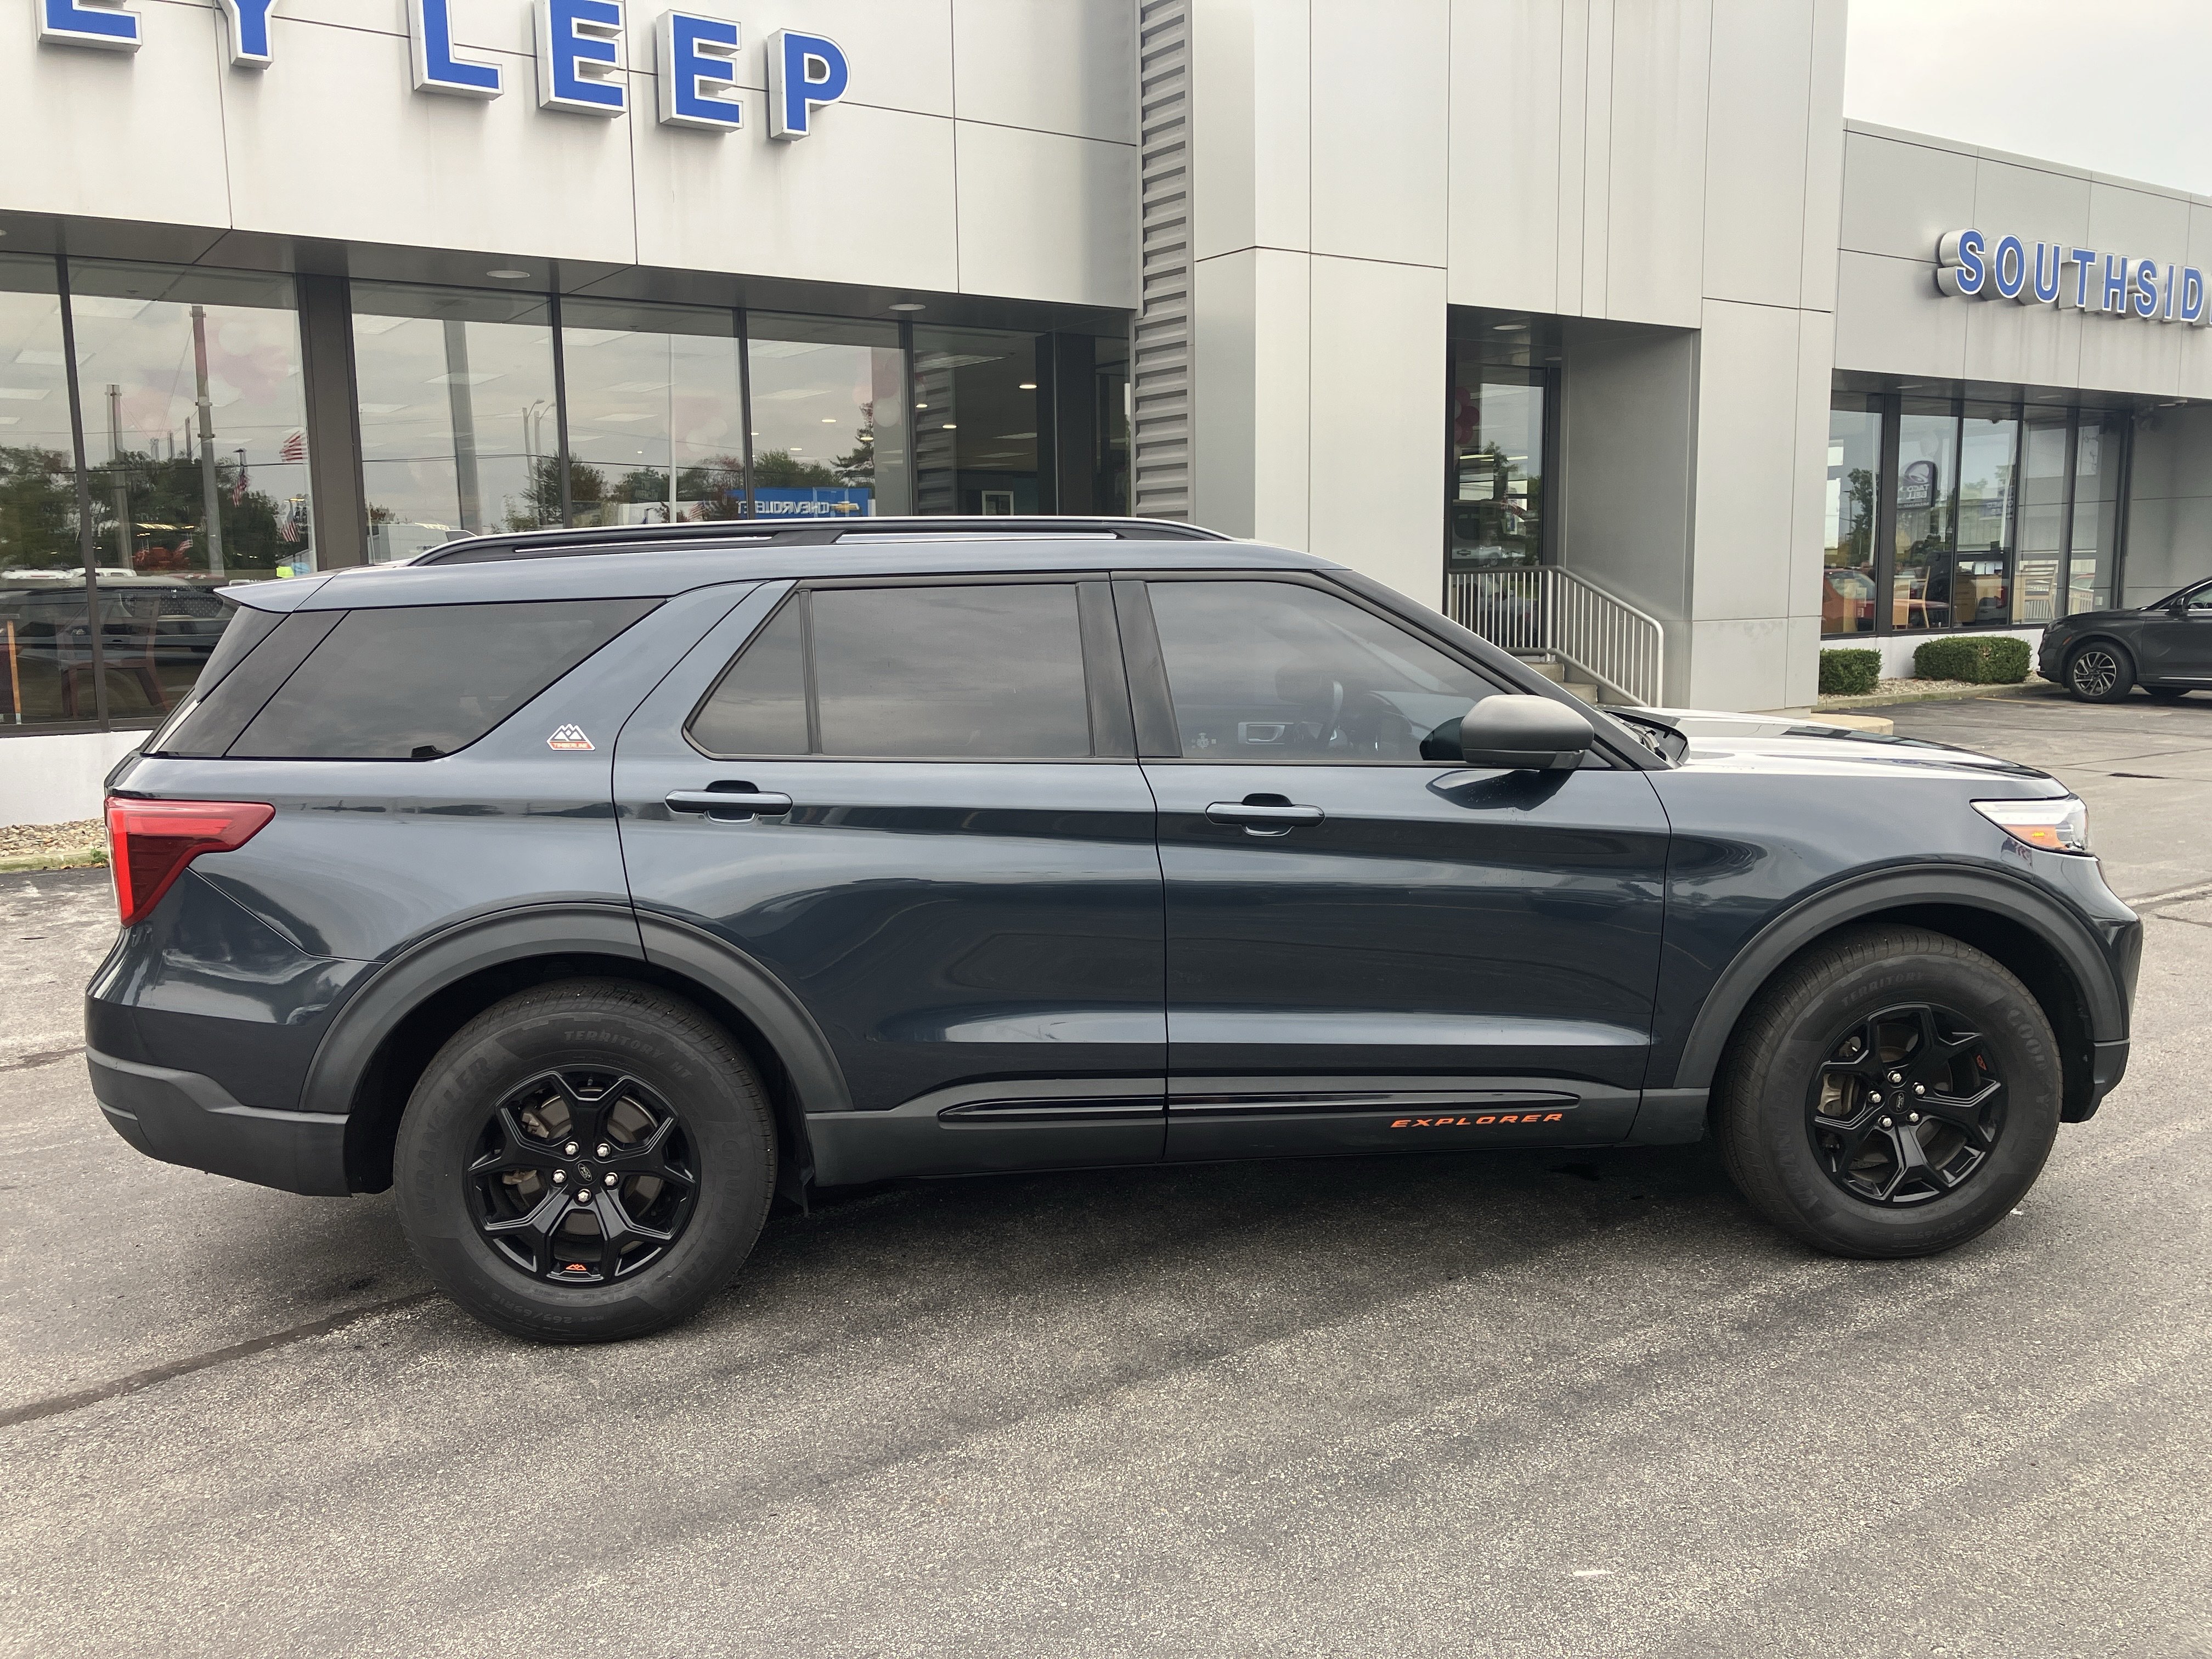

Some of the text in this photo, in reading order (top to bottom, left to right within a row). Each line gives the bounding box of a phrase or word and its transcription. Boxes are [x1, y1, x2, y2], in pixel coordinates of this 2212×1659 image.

[409, 0, 851, 142] LEEP
[1938, 228, 2212, 325] SOUTHSID
[563, 1029, 664, 1059] TERRITORY
[670, 1061, 693, 1079] HT
[415, 1053, 495, 1220] WRANGLER
[1390, 1113, 1562, 1128] EXPLORER
